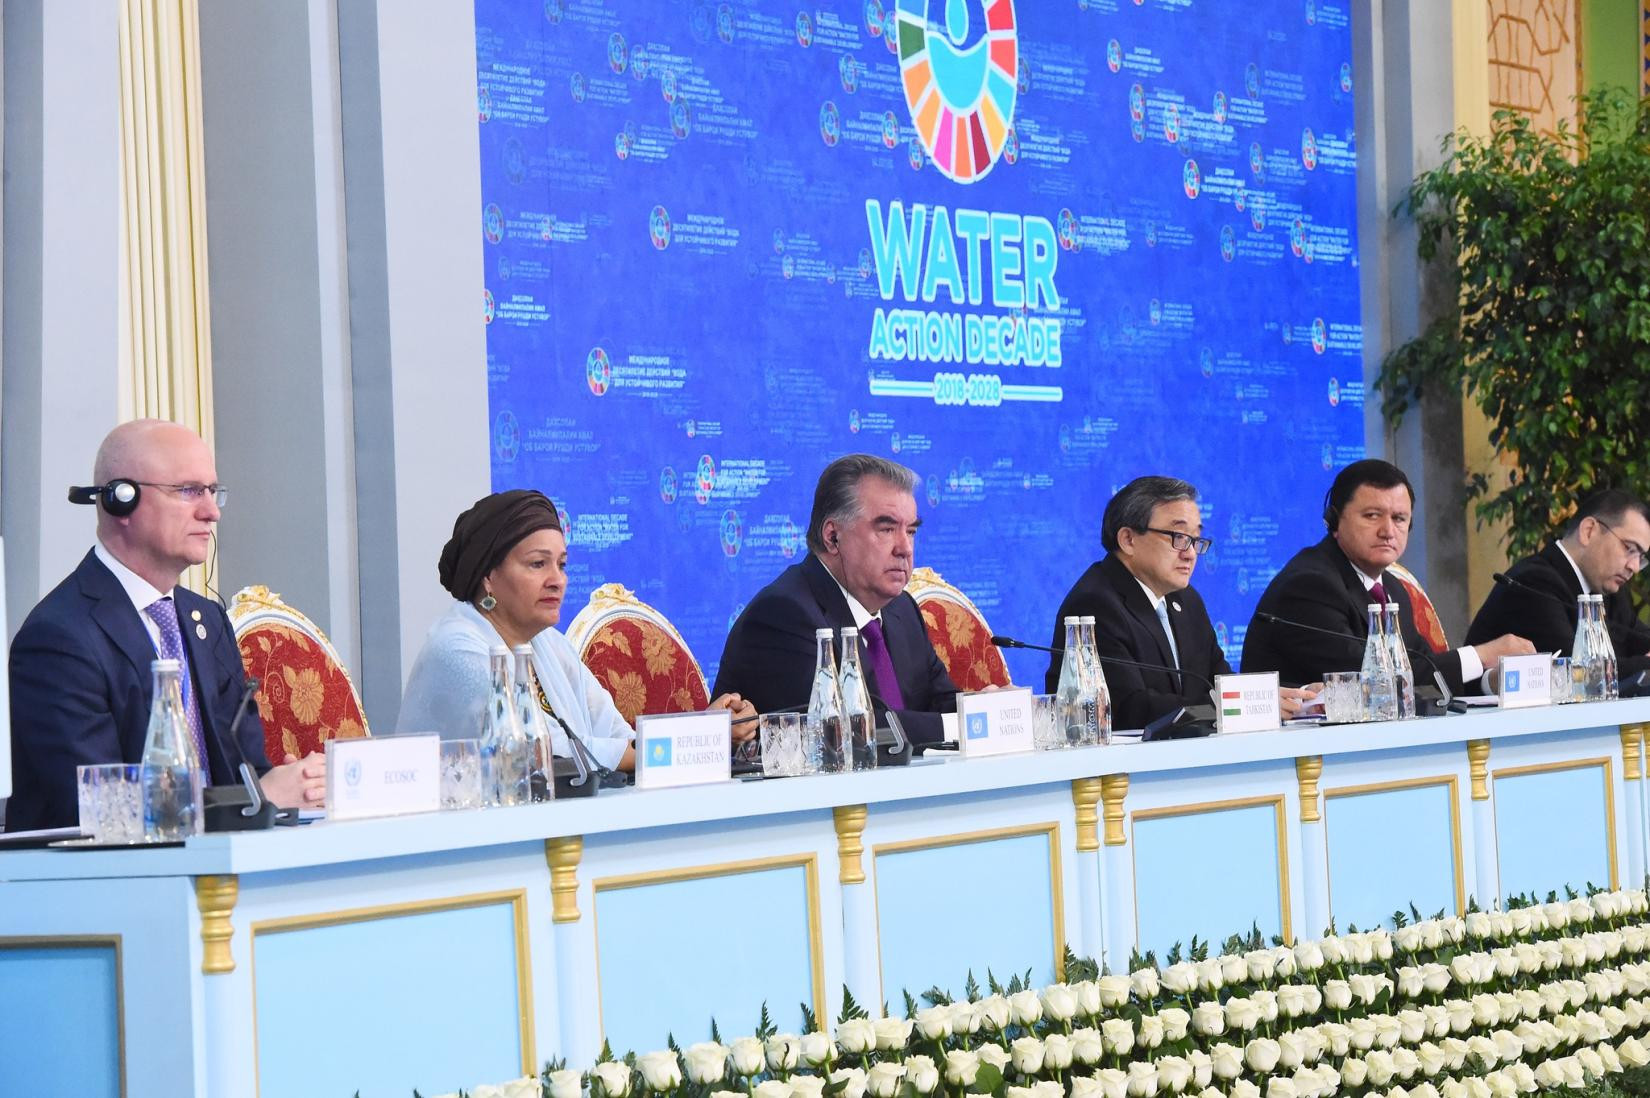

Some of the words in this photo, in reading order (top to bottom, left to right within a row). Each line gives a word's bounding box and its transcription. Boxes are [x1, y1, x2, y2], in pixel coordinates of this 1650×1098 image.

[866, 198, 1060, 311] WATER
[869, 308, 963, 363] ACTION
[965, 314, 1062, 367] DECADE
[934, 373, 1002, 406] 2018-2028
[999, 708, 1022, 721] UNITED
[999, 724, 1024, 737] NATIONS
[676, 735, 711, 749] REPUBLIC
[713, 733, 722, 747] OF
[676, 751, 725, 766] KAZAKHSTAN
[383, 767, 420, 785] ECOSOC
